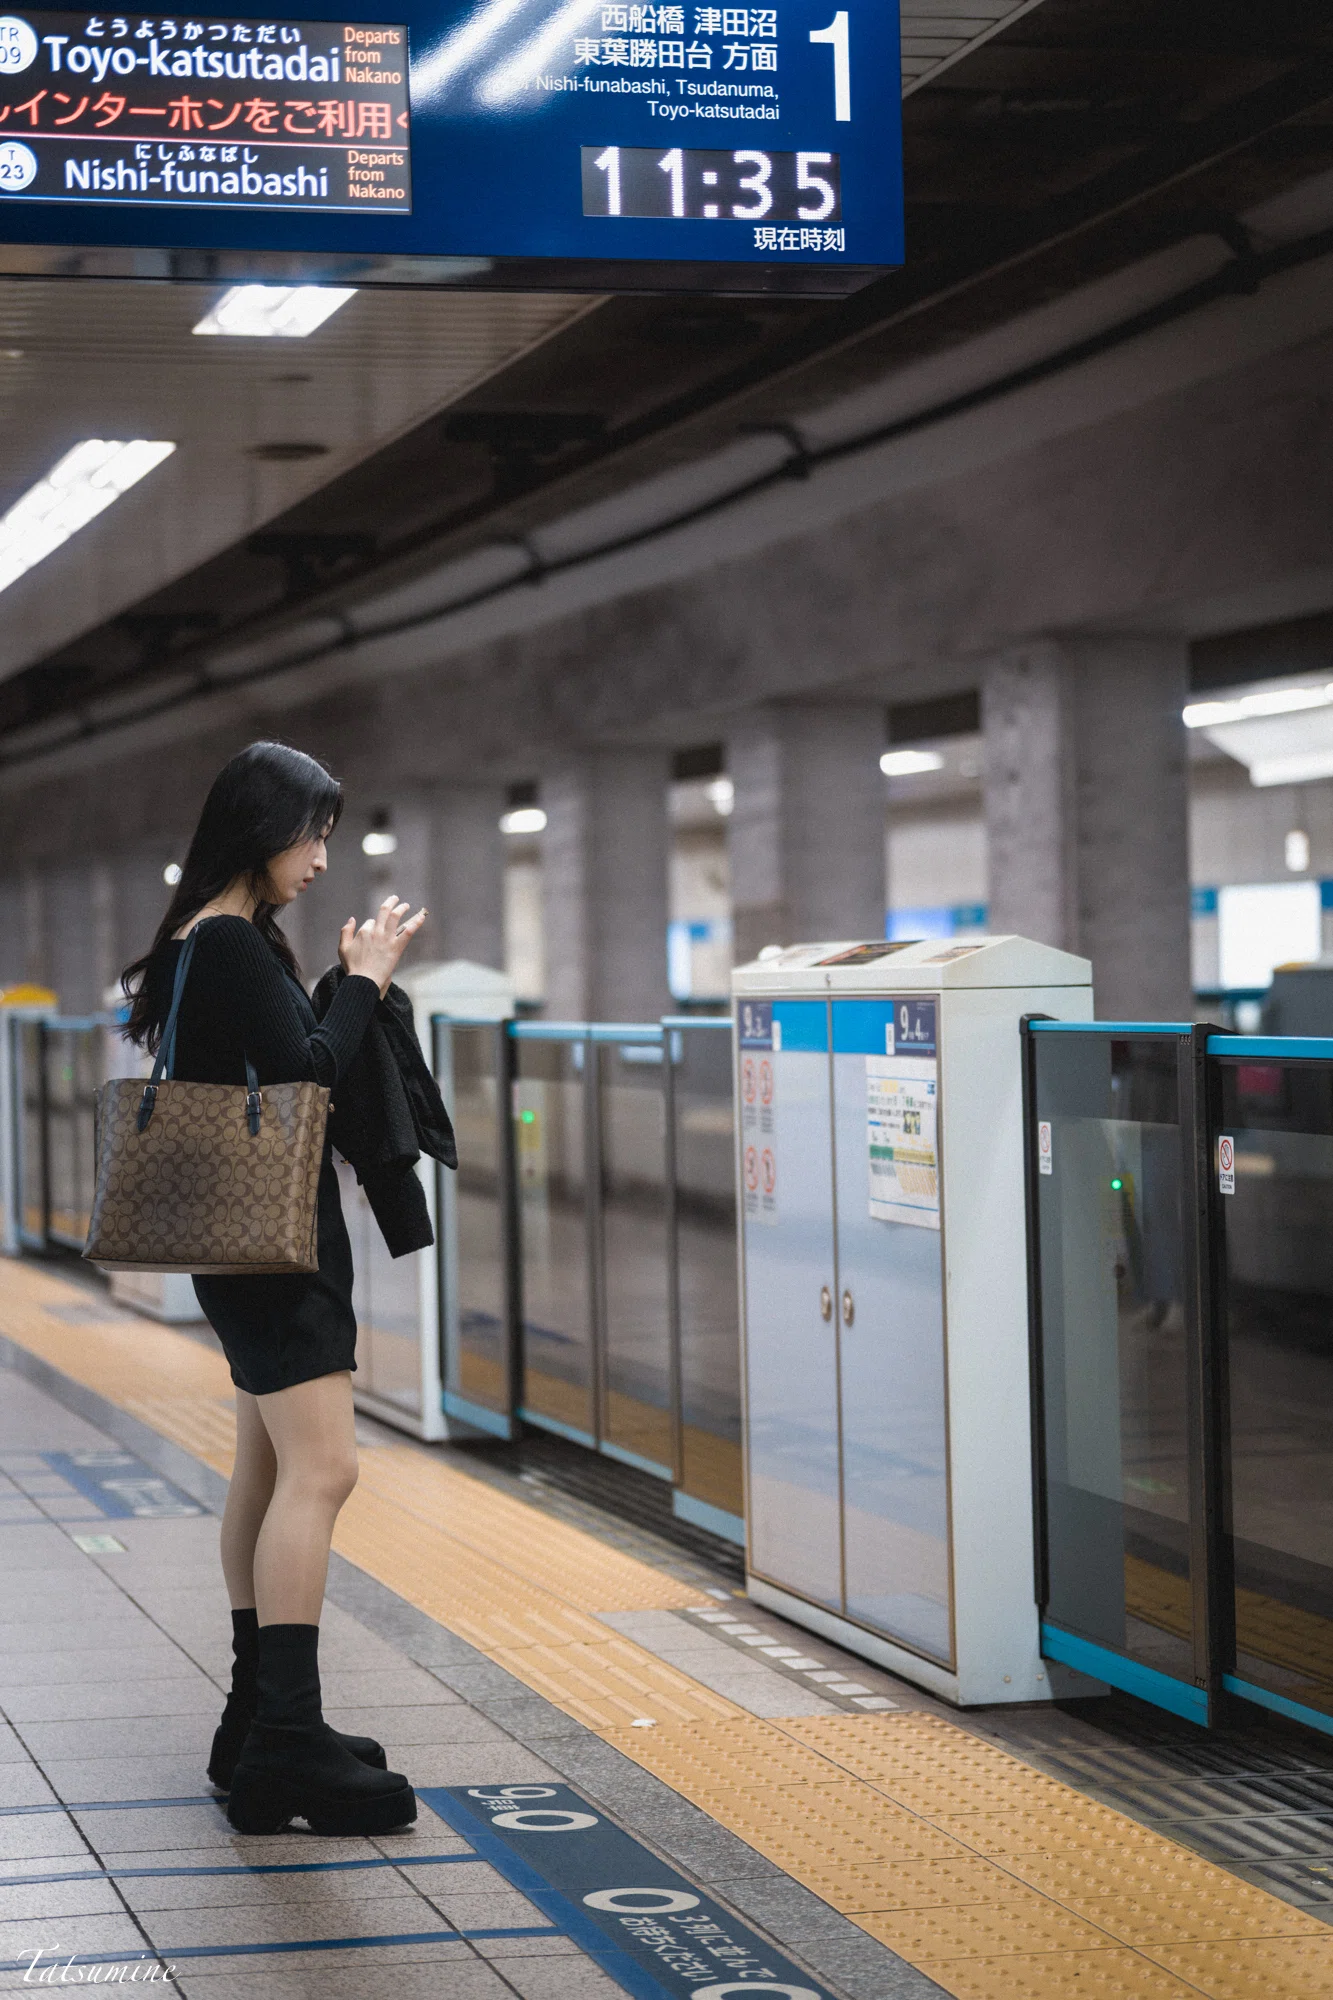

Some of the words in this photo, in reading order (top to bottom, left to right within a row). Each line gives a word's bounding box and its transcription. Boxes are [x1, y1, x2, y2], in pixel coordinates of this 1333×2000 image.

[85, 17, 300, 44] とうようかつただい
[601, 4, 685, 35] 西船橋
[693, 7, 777, 38] 津田沼
[344, 27, 400, 46] Departs
[43, 35, 341, 83] Toyo-katsutadai
[344, 46, 382, 64] from
[574, 38, 713, 70] 東葉勝田台
[723, 42, 778, 71] 方面
[345, 66, 402, 84] Nakano
[809, 11, 851, 122] 1
[536, 75, 670, 95] Nishi-funabashi,
[675, 80, 779, 99] Tsudanuma,
[647, 100, 780, 121] Toyo-katsutadai
[8, 150, 15, 160] T
[135, 143, 259, 163] にしふなばし
[348, 150, 404, 167] Departs
[1, 164, 24, 179] 23
[65, 158, 329, 197] Nishi-funabashi
[348, 166, 385, 182] from
[349, 183, 405, 199] Nakano
[594, 146, 836, 220] 11:35
[753, 227, 846, 252] 現在時刻
[619, 1916, 719, 1981] お待ちください
